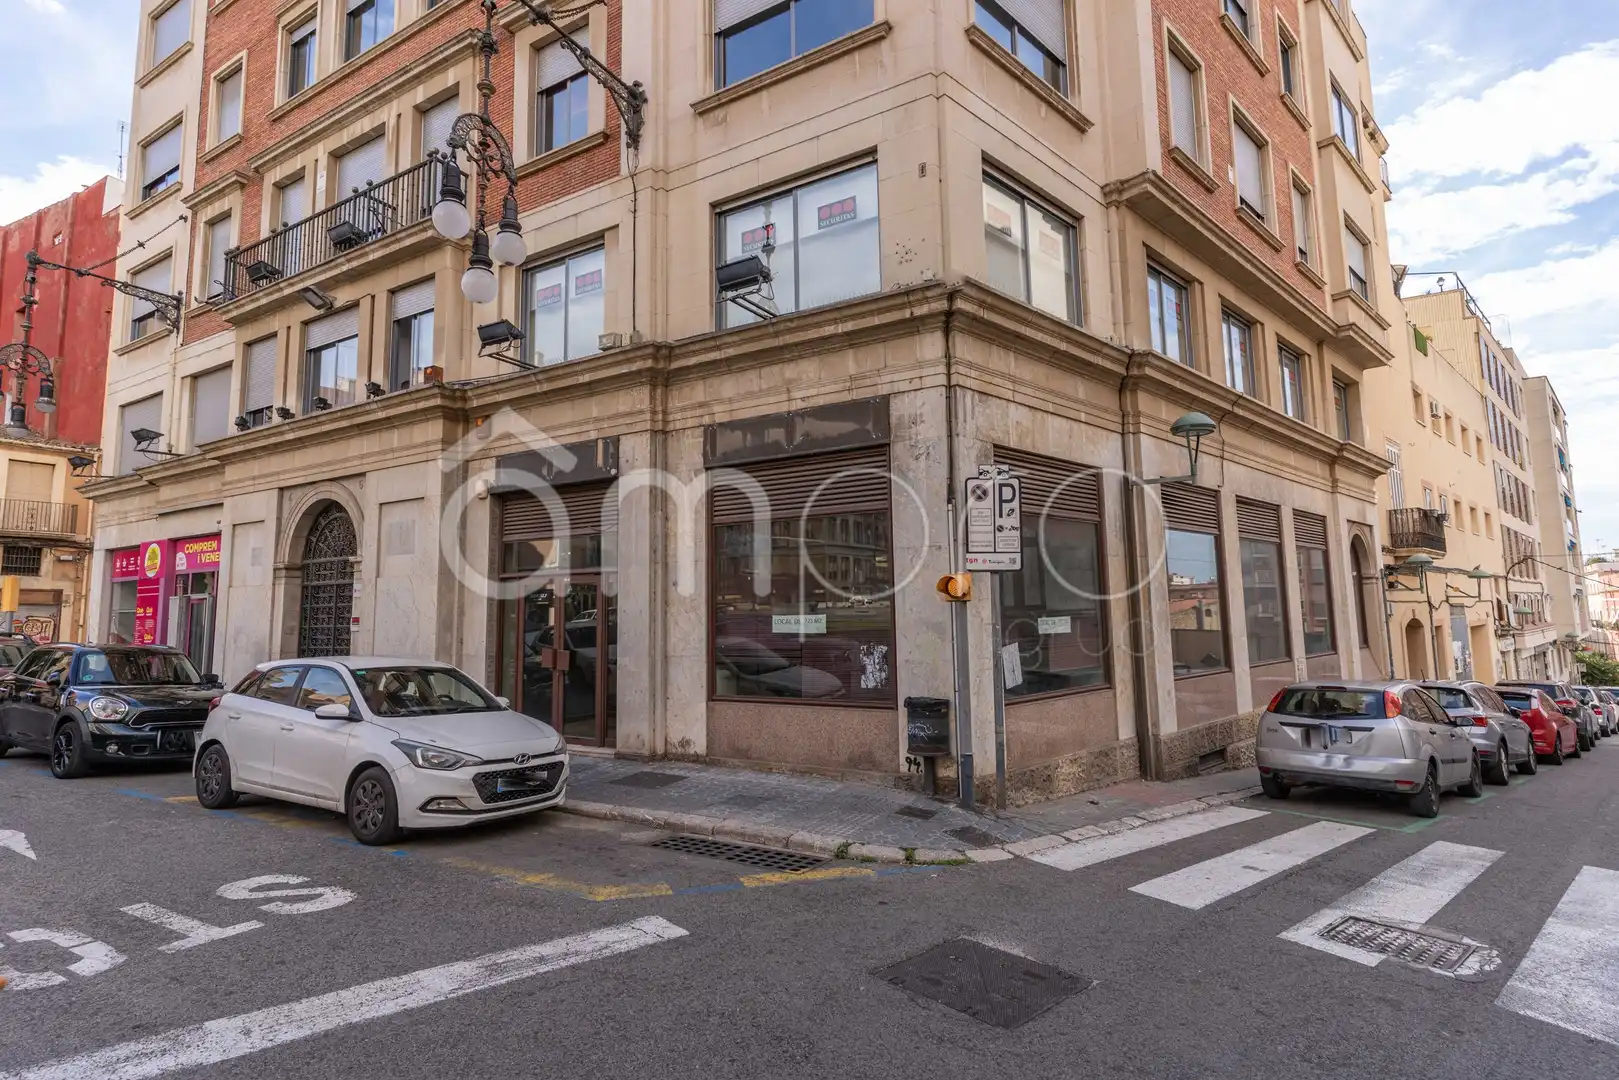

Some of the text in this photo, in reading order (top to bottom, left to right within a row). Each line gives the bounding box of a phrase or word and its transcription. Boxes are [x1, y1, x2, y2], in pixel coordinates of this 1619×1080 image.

[819, 212, 855, 228] SECURITAS
[998, 482, 1017, 519] P
[184, 540, 217, 553] COMPREM
[773, 617, 792, 625] LOCAL
